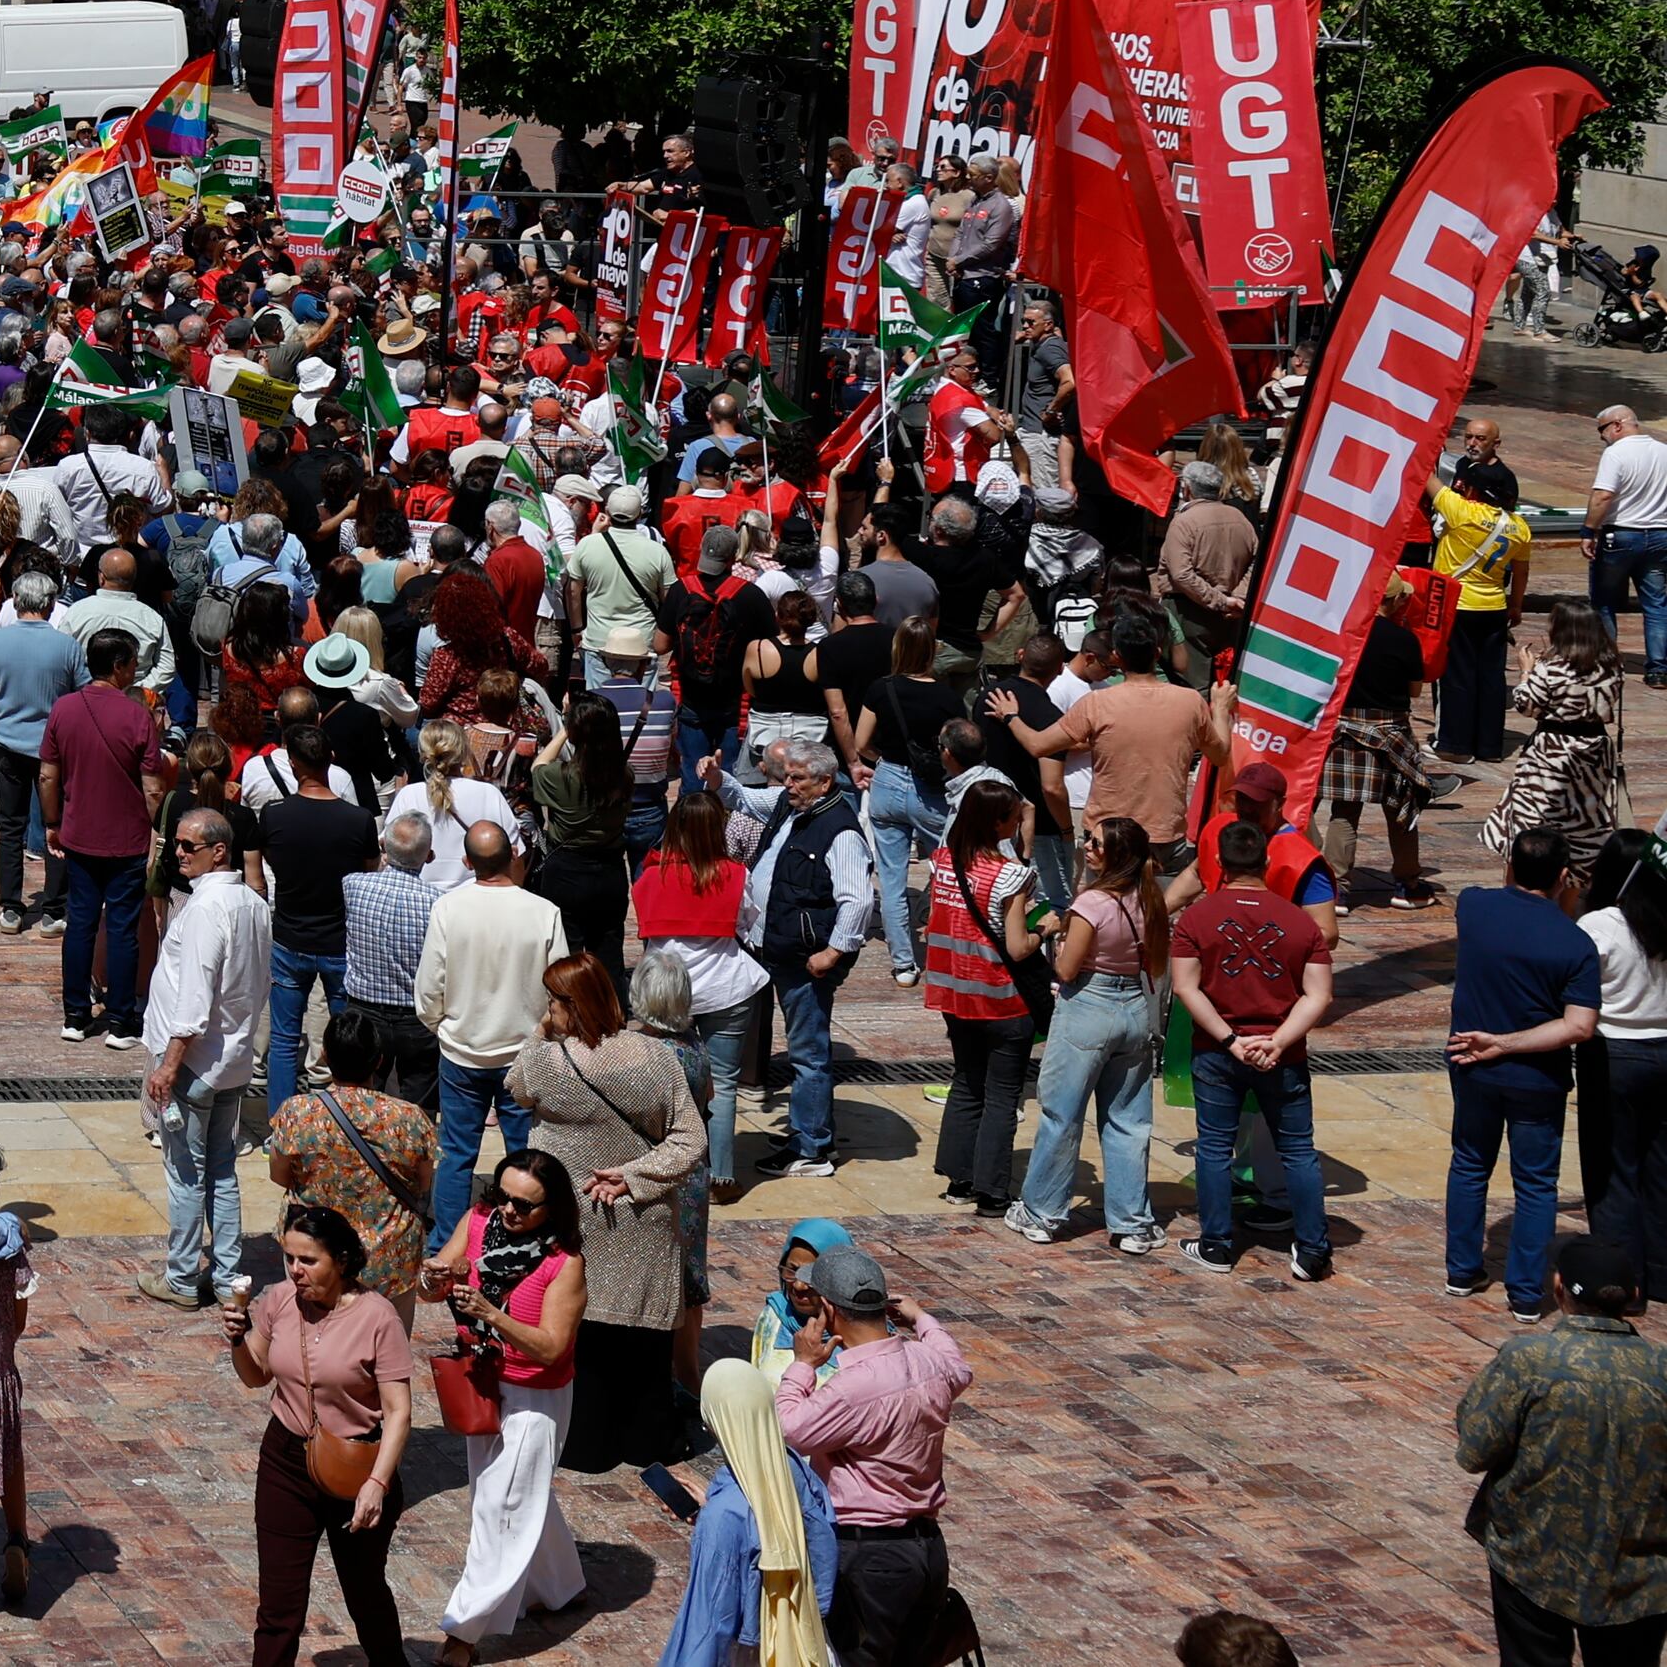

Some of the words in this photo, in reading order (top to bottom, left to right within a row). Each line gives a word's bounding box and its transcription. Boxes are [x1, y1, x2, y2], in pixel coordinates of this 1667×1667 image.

[933, 65, 969, 113] de
[1210, 3, 1291, 230] UGT
[343, 176, 369, 195] CCOO
[345, 191, 375, 208] hábitat
[613, 247, 627, 268] de
[597, 263, 629, 288] mayo
[238, 384, 287, 402] TEMPORALIDAD
[246, 393, 274, 405] ABUSIVA
[1266, 190, 1499, 635] CCOO
[1427, 578, 1445, 628] CCOO
